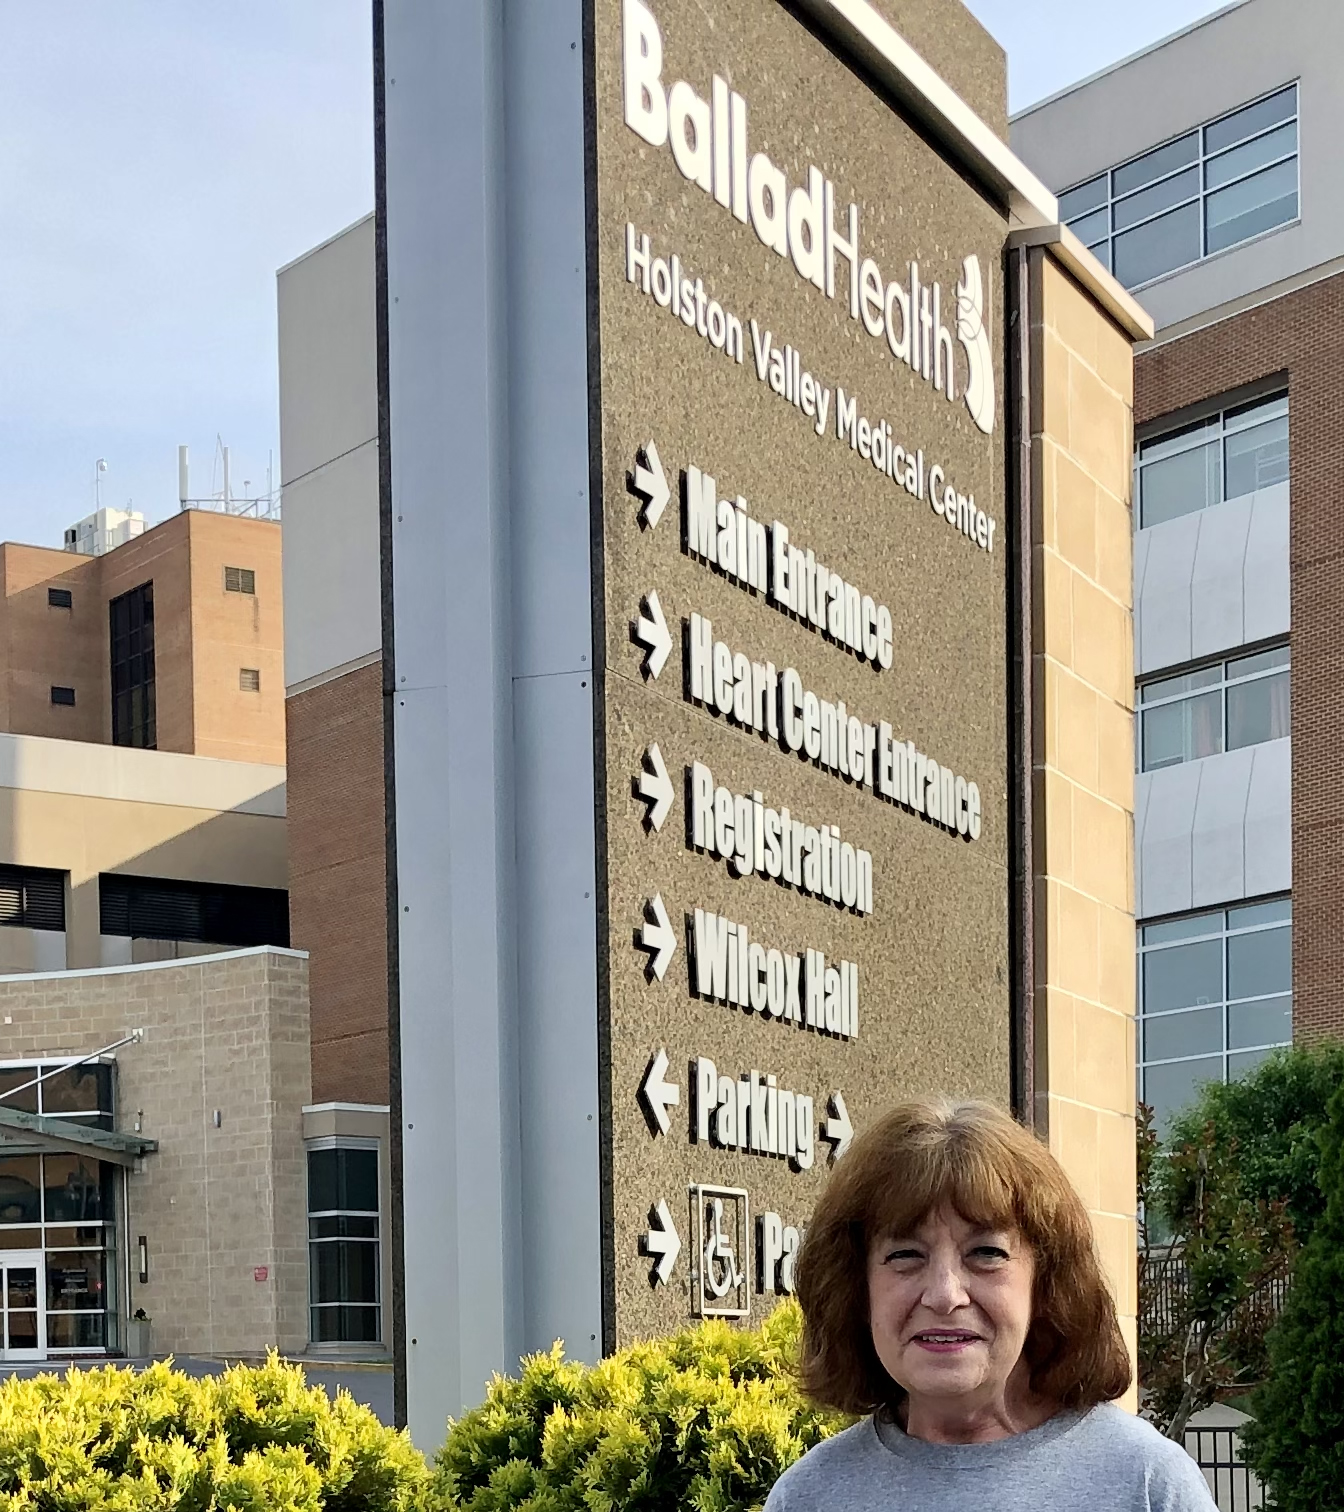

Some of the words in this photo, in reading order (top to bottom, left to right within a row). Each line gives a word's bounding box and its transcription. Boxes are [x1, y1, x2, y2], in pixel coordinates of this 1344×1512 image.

[625, 222, 744, 364] Holston
[751, 319, 830, 436] Valley
[836, 388, 924, 500] Medical
[929, 464, 997, 553] Center
[686, 463, 768, 595] Main
[772, 519, 893, 670] Entrance
[690, 611, 780, 741] Heart
[782, 667, 877, 787] Center
[878, 719, 982, 842] Entrance
[692, 760, 874, 915] Registration
[694, 908, 802, 1023] Wilcox
[805, 947, 859, 1039] Hall
[697, 1055, 815, 1170] Parking
